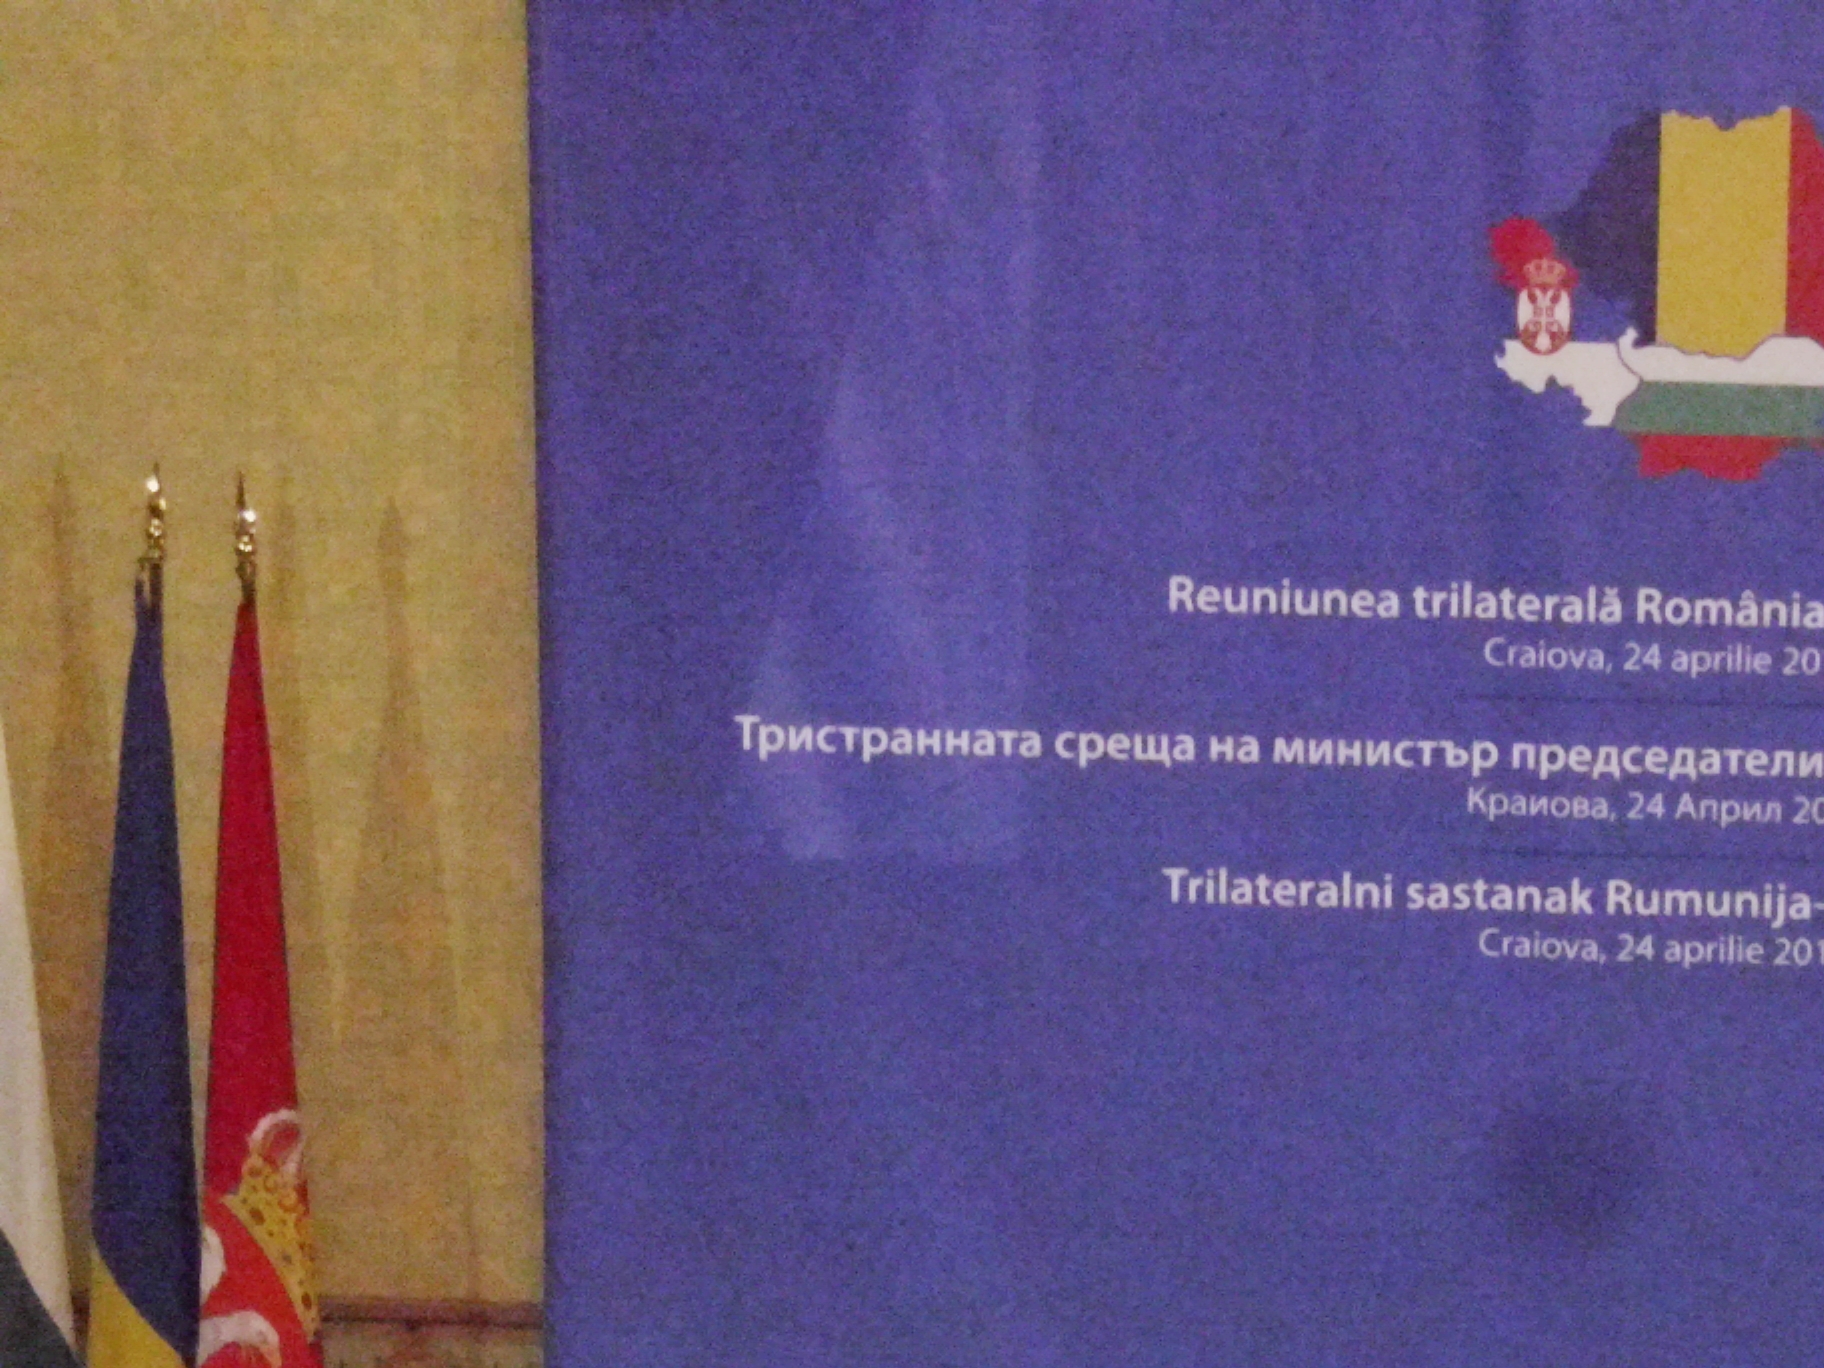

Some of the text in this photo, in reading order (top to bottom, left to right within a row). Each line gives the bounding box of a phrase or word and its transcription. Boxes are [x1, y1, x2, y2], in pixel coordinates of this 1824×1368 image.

[1169, 575, 1400, 618] Reuniunea
[1413, 581, 1622, 623] trilaterală
[1484, 638, 1610, 671] Craiova,
[1623, 642, 1662, 671] 24
[1672, 646, 1771, 677] aprilie
[734, 714, 1042, 762] Тристранната
[1055, 731, 1195, 768] среща
[1209, 735, 1260, 764] на
[1273, 737, 1498, 777] министър
[1627, 792, 1665, 819] 24
[1676, 794, 1781, 827] Април
[1163, 867, 1392, 908] Trilateralni
[1407, 878, 1592, 914] sastanak
[1479, 929, 1605, 962] Craiova,
[1617, 933, 1654, 962] 24
[1665, 937, 1763, 967] aprilie
